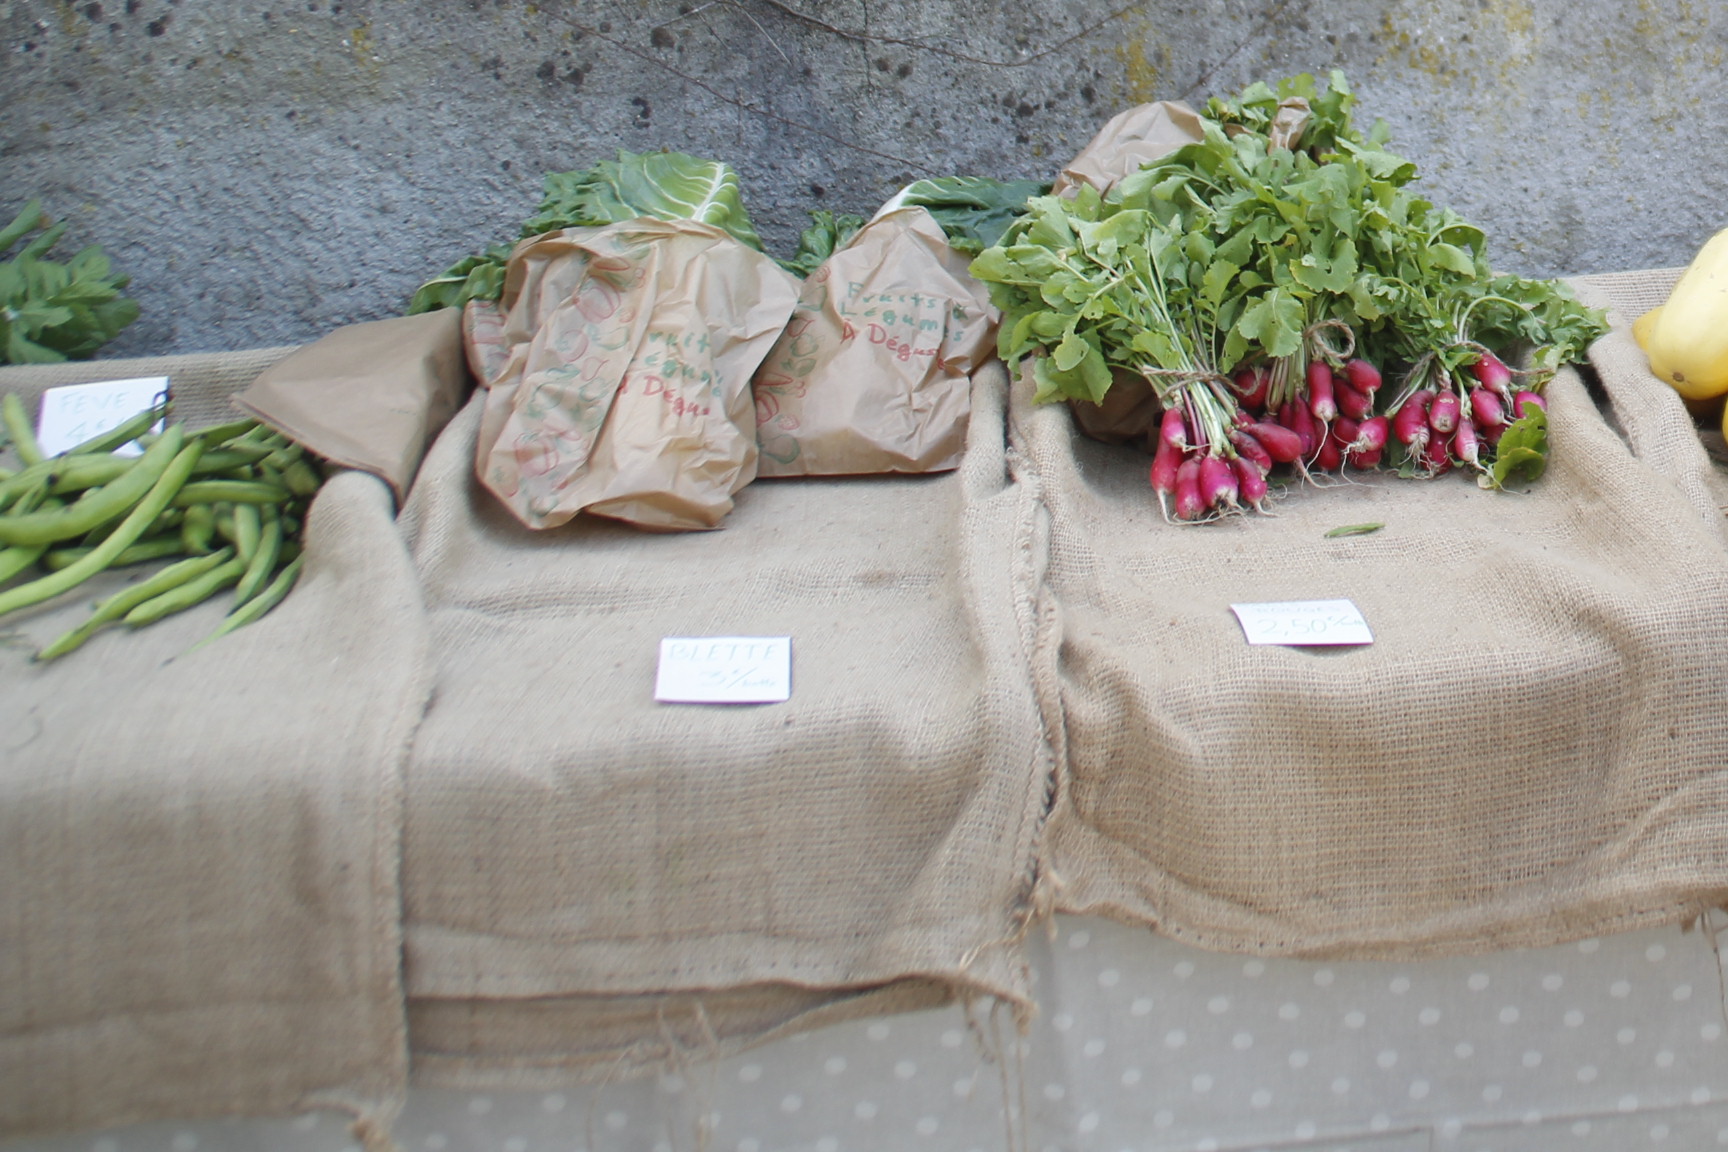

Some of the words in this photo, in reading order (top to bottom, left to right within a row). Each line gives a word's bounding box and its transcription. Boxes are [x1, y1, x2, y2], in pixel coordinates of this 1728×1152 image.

[847, 281, 936, 309] Fruits
[58, 390, 130, 415] FEVE
[668, 643, 778, 662] BLETTE
